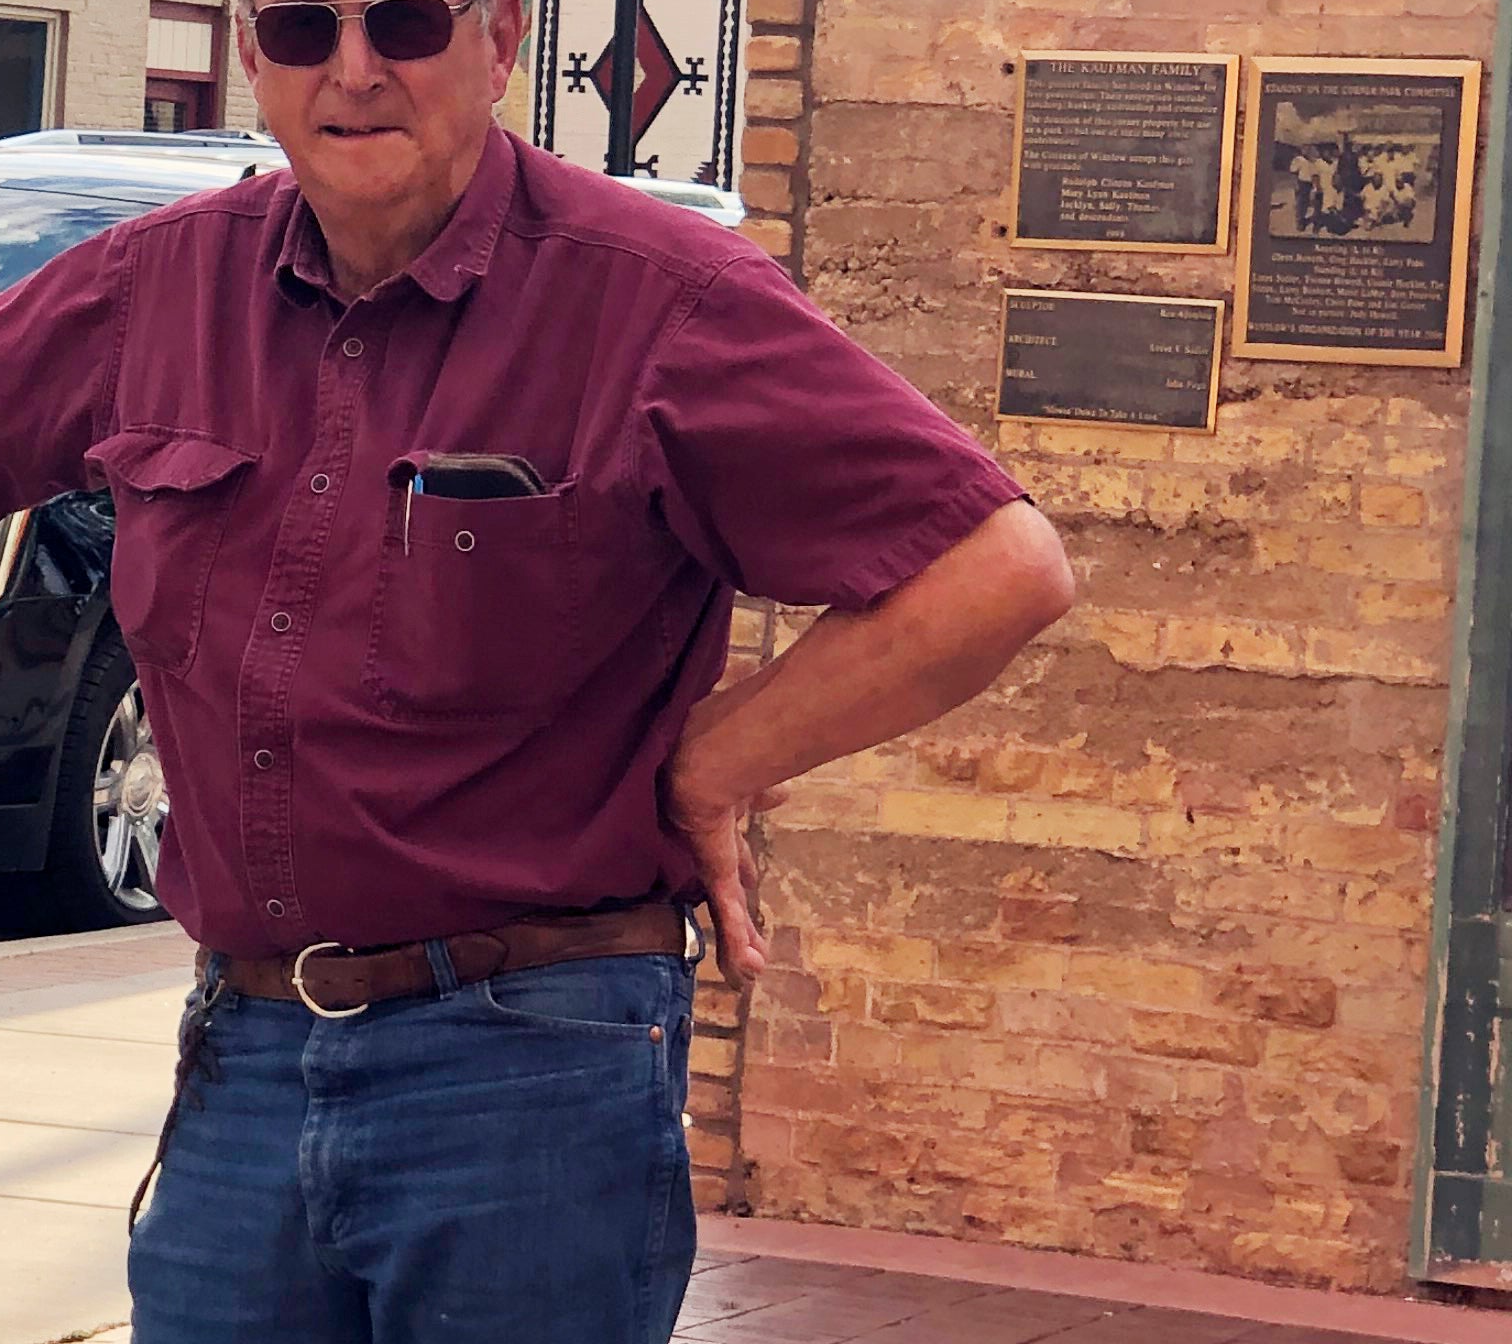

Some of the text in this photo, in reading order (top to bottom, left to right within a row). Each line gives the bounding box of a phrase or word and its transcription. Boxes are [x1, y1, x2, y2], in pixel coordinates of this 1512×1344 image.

[1050, 62, 1201, 76] THE KAUFMAN FAMILY
